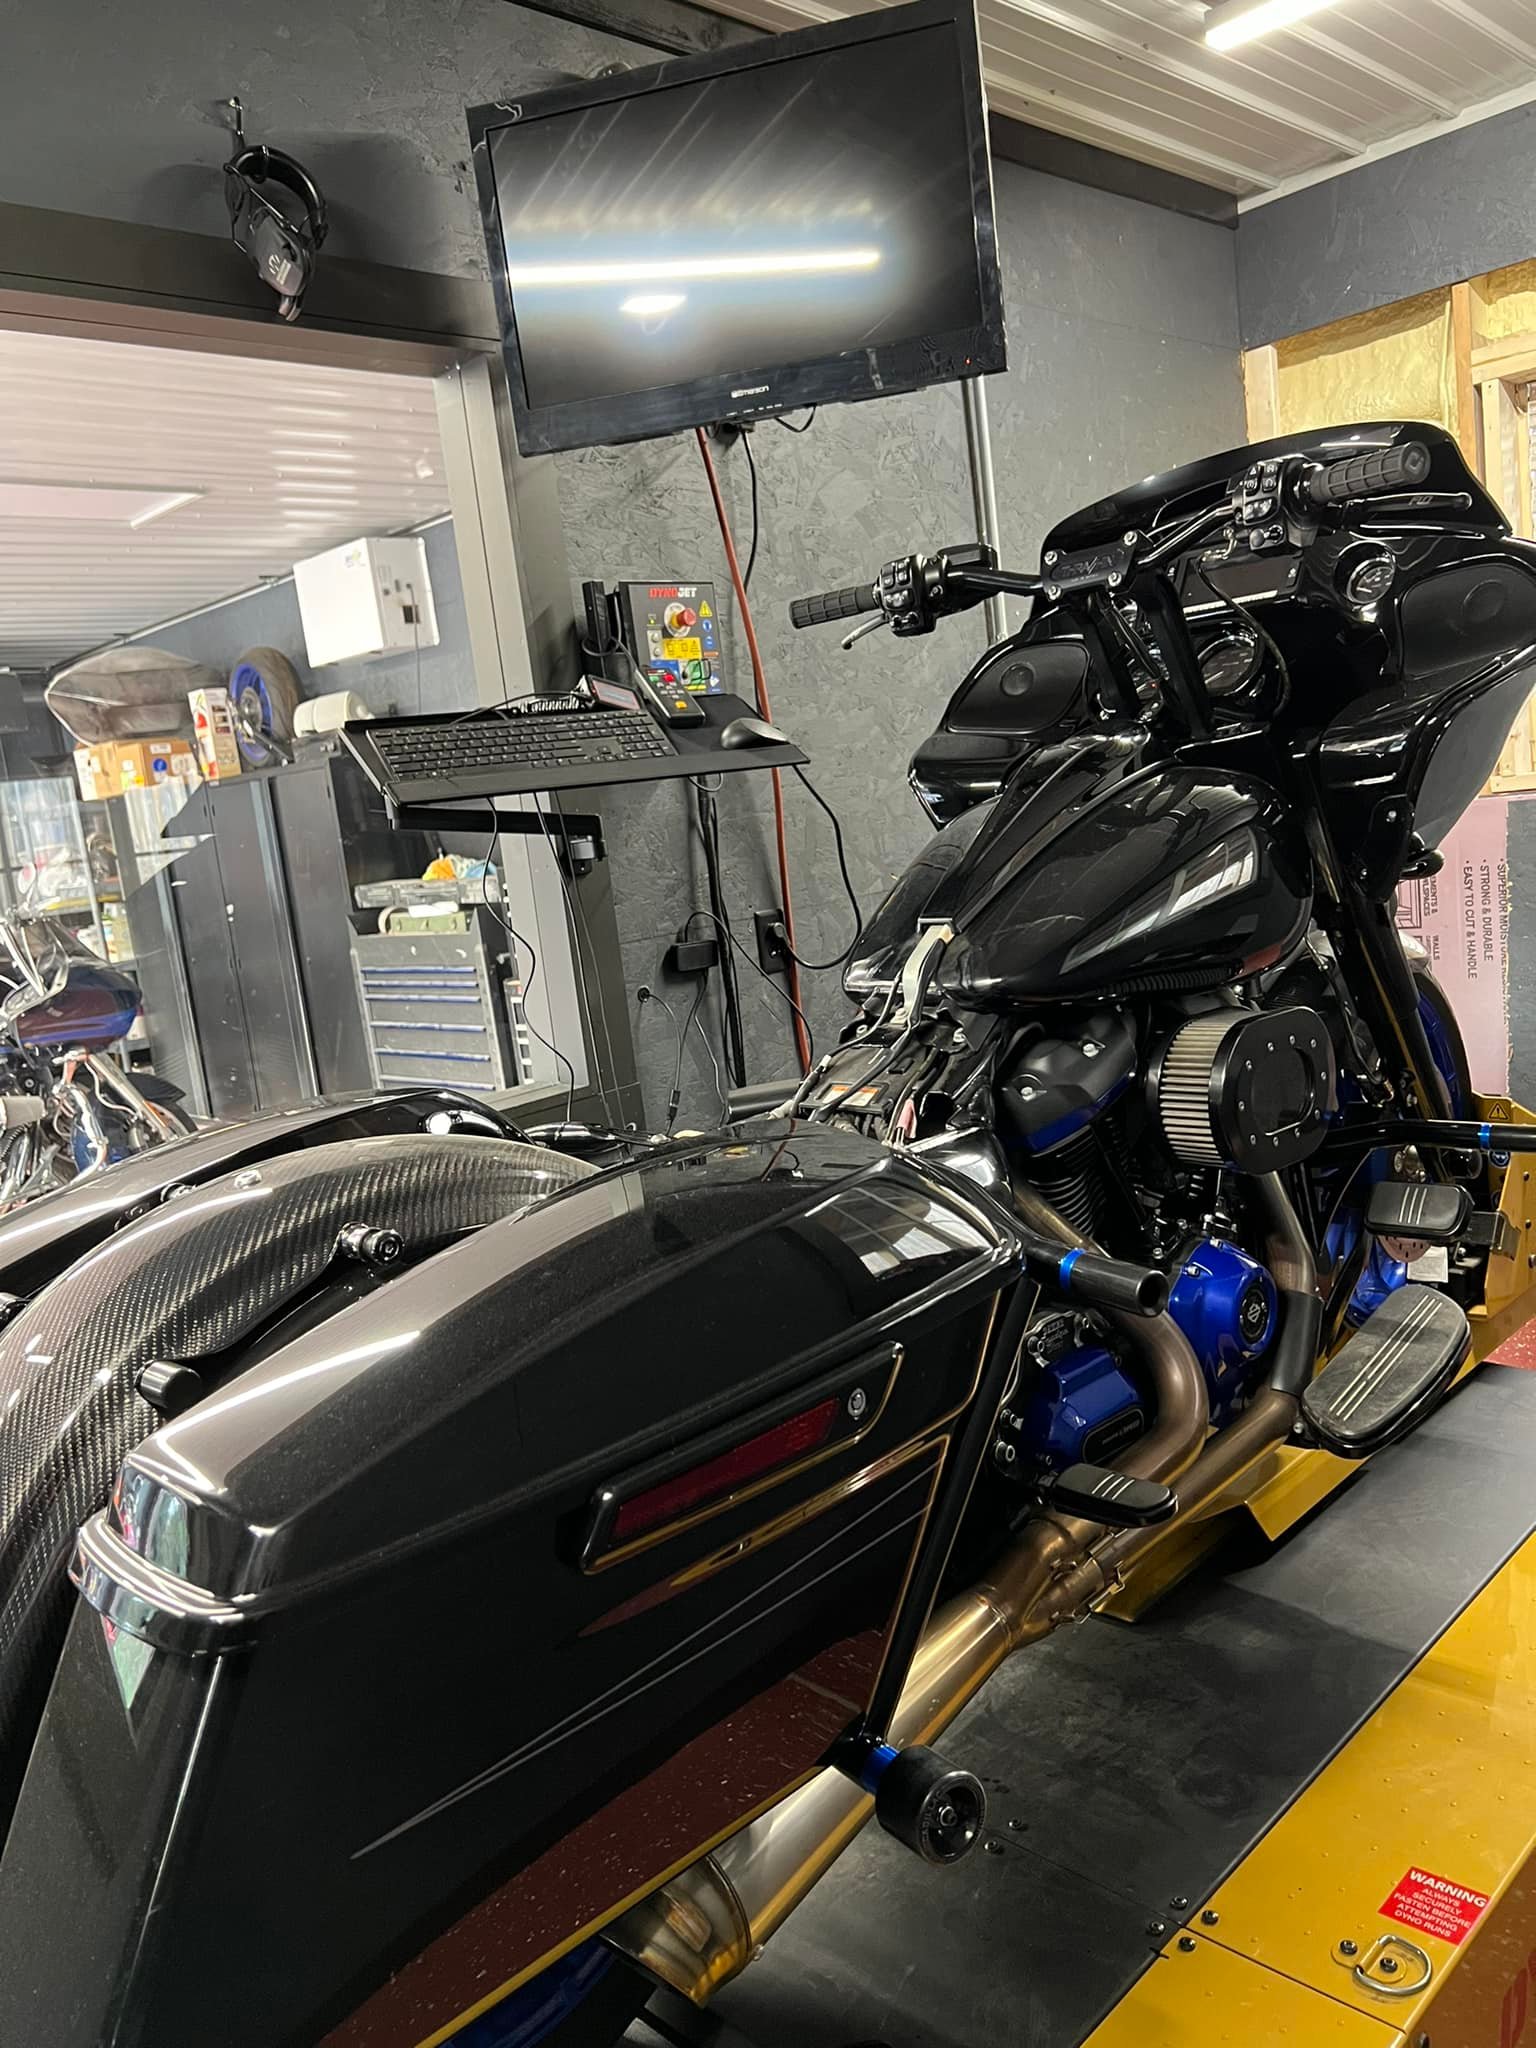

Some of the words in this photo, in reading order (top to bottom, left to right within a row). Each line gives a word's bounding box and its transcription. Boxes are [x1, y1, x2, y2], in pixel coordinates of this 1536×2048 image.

[1430, 876, 1438, 908] EMENTS
[1463, 866, 1473, 892] EASY
[1480, 865, 1491, 905] STRONG
[1497, 864, 1508, 913] SUPERIOR
[1465, 893, 1474, 907] TO
[1465, 909, 1475, 929] CUT
[1482, 916, 1494, 961] DURABLE
[1466, 940, 1477, 979] HANDLE
[1410, 1870, 1488, 1908] WARNING
[1412, 1892, 1463, 1915] SECURELY
[1422, 1888, 1461, 1907] ALWAYS
[1394, 1893, 1431, 1911] FASTEN
[1432, 1908, 1472, 1929] BEFORE
[1394, 1910, 1423, 1926] DYNO
[1424, 1922, 1452, 1938] RUNS
[1397, 1903, 1458, 1931] ATTEMPTING
